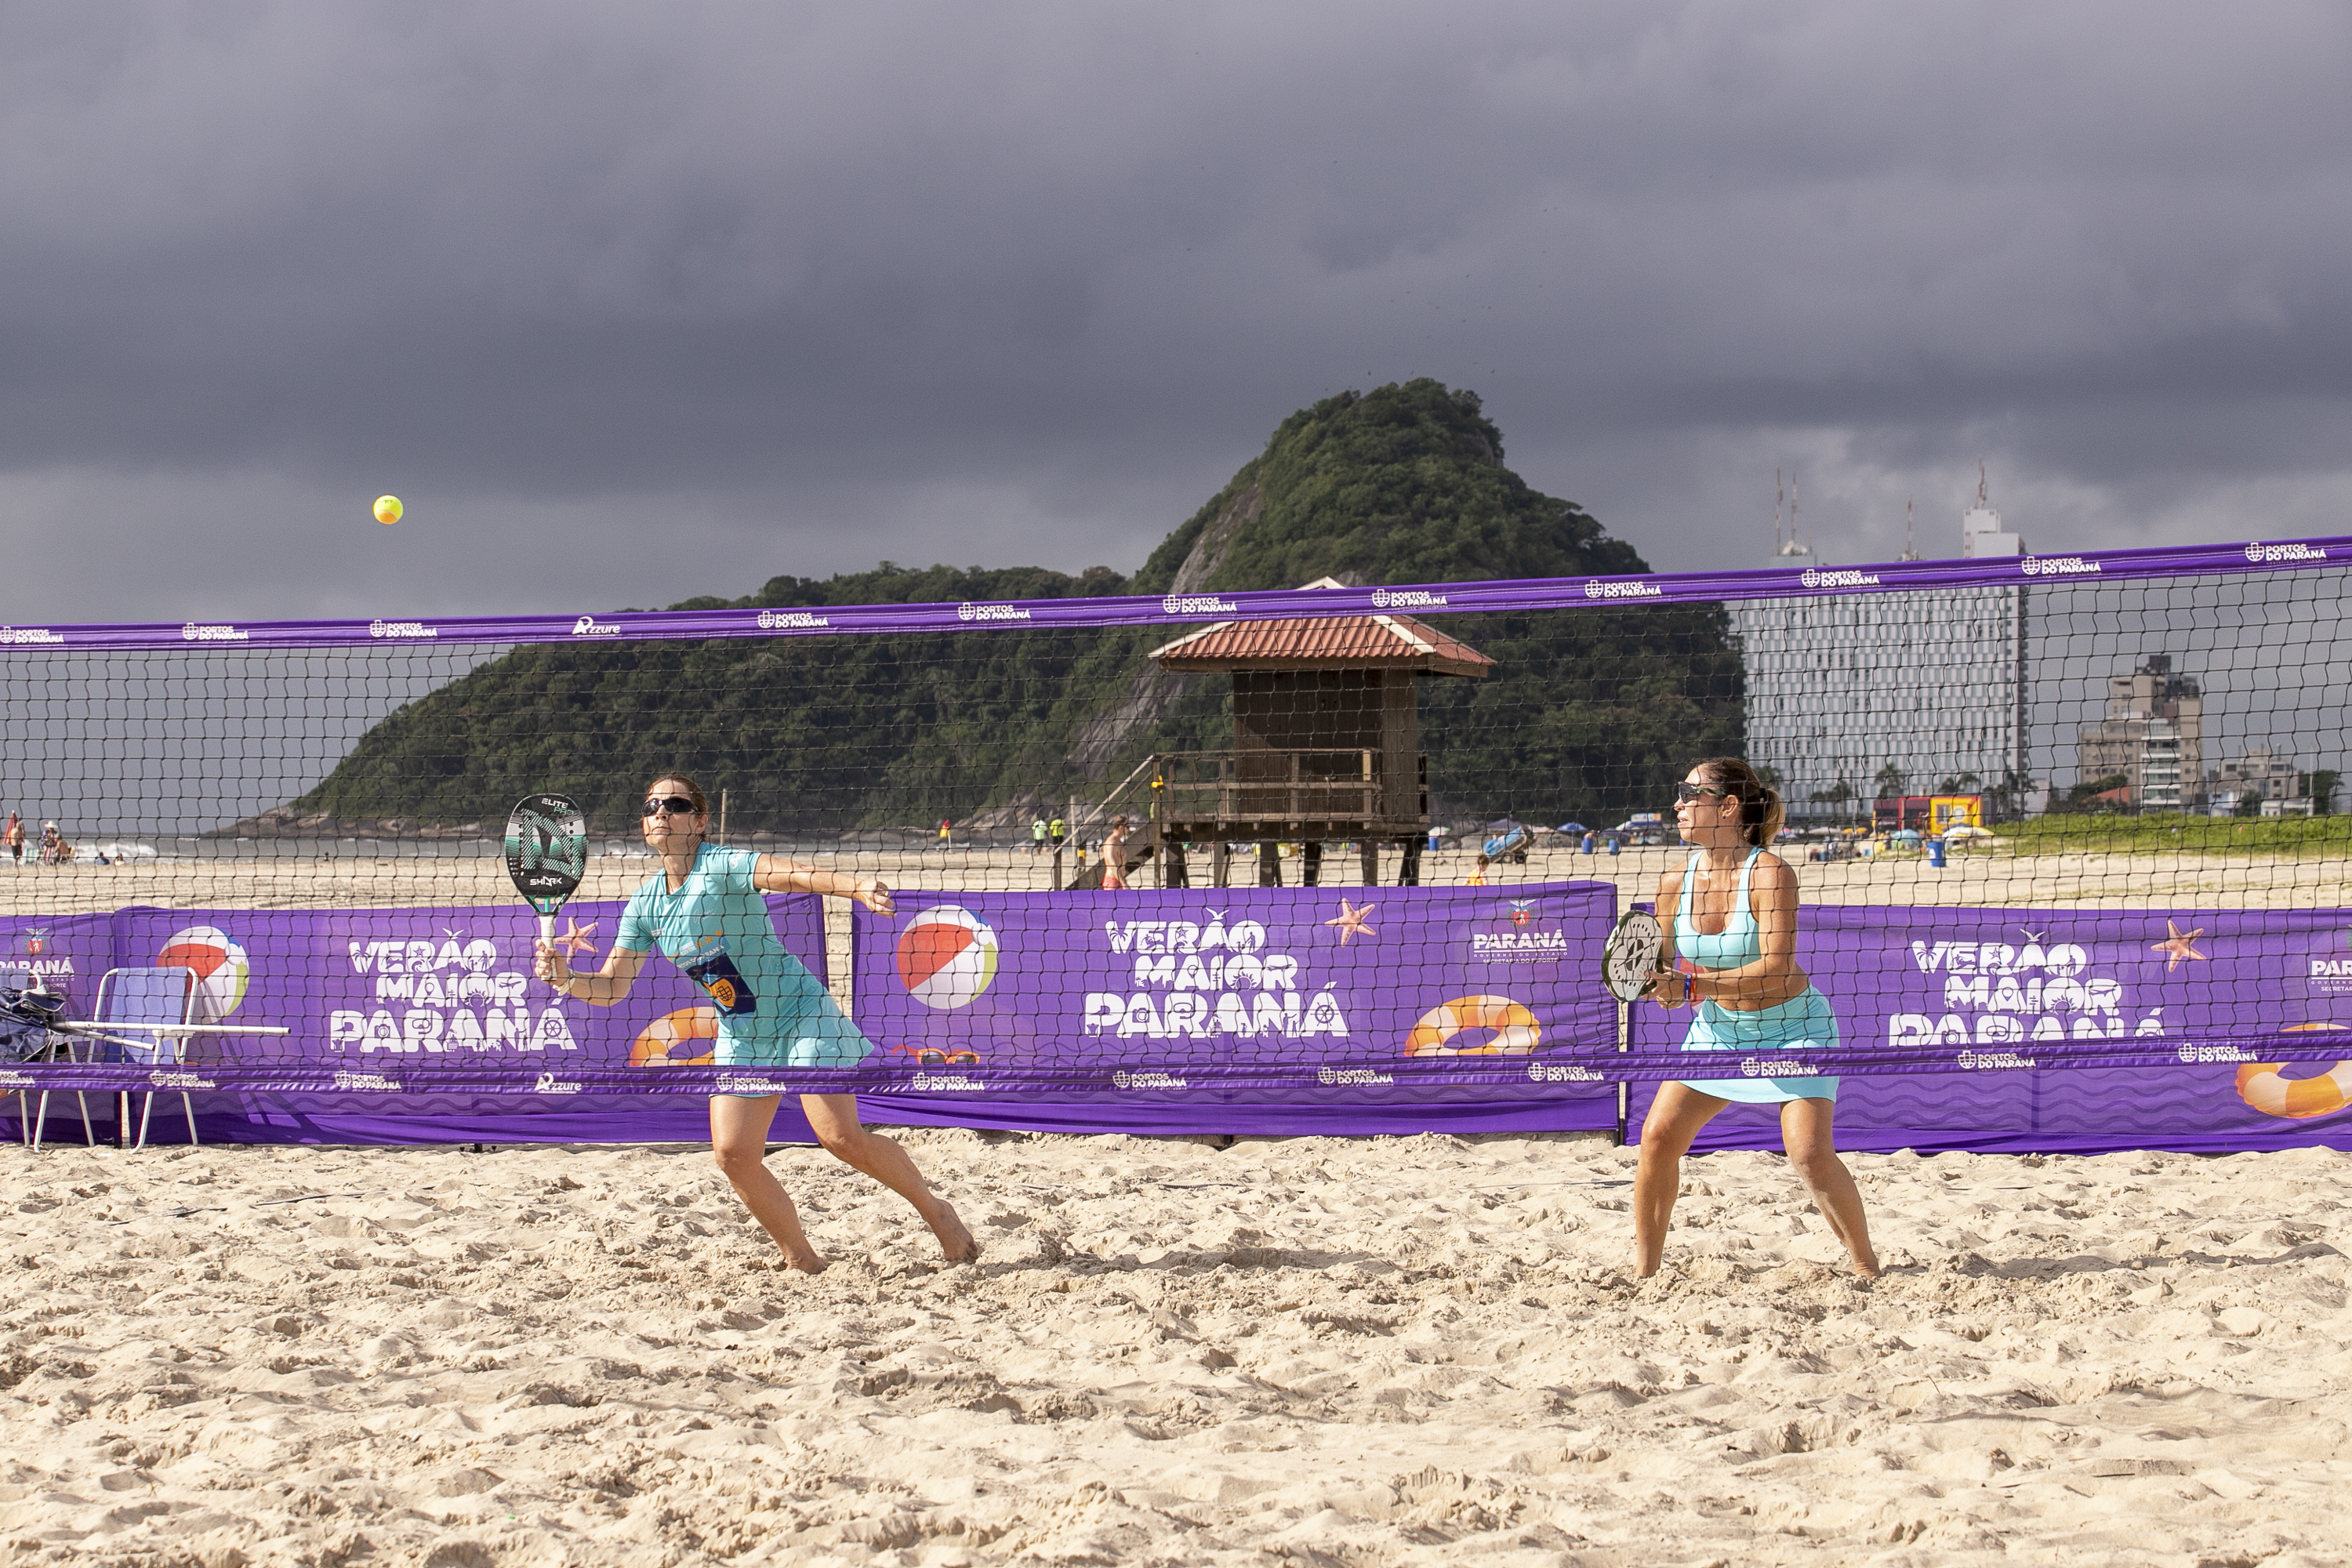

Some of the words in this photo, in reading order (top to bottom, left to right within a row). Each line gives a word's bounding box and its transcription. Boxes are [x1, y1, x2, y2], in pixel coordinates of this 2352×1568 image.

[2266, 552, 2281, 561] DO
[2284, 548, 2326, 559] PARANÁ
[2042, 557, 2082, 566] PORTOS
[2042, 565, 2057, 574] DO
[2060, 561, 2101, 572] PARANÁ
[1821, 571, 1861, 579] PORTOS
[1821, 578, 1837, 586] DO
[1838, 575, 1879, 586] PARANÁ
[1604, 589, 1620, 597] DO
[1621, 586, 1661, 597] PARANÁ
[1408, 596, 1447, 605] PARANÁ
[1181, 604, 1196, 613] DO
[1198, 602, 1236, 612] PARANÁ
[992, 609, 1030, 619] PARANÁ
[791, 617, 828, 626] PARANÁ
[401, 628, 437, 637] PARANÁ
[29, 634, 64, 643] PARANÁ
[542, 798, 568, 808] ELITE
[530, 876, 562, 887] SHARK
[1105, 908, 1265, 954] VERÃO
[1474, 929, 1566, 949] PARANÁ
[349, 927, 497, 973] VERÃO
[1911, 928, 2087, 977] VERÃO
[1134, 954, 1298, 991] MAIOR
[2311, 960, 2352, 975] PAR
[376, 972, 527, 1008] MAIOR
[1944, 976, 2122, 1016] MAIOR
[1085, 982, 1350, 1038] PARANÁ
[331, 997, 577, 1052] PARANÁ
[2216, 1051, 2257, 1062] PARANÁ
[1994, 1058, 2036, 1068] PARANÁ
[1778, 1065, 1818, 1075] PARANÁ
[1354, 1074, 1393, 1083] PARANÁ
[1564, 1071, 1604, 1081] PARANÁ
[181, 1079, 215, 1087] PARANÁ
[365, 1080, 401, 1090] PARANÁ
[749, 1082, 786, 1091] PARANÁ
[947, 1081, 985, 1091] PARANÁ
[1149, 1078, 1187, 1087] PARANÁ
